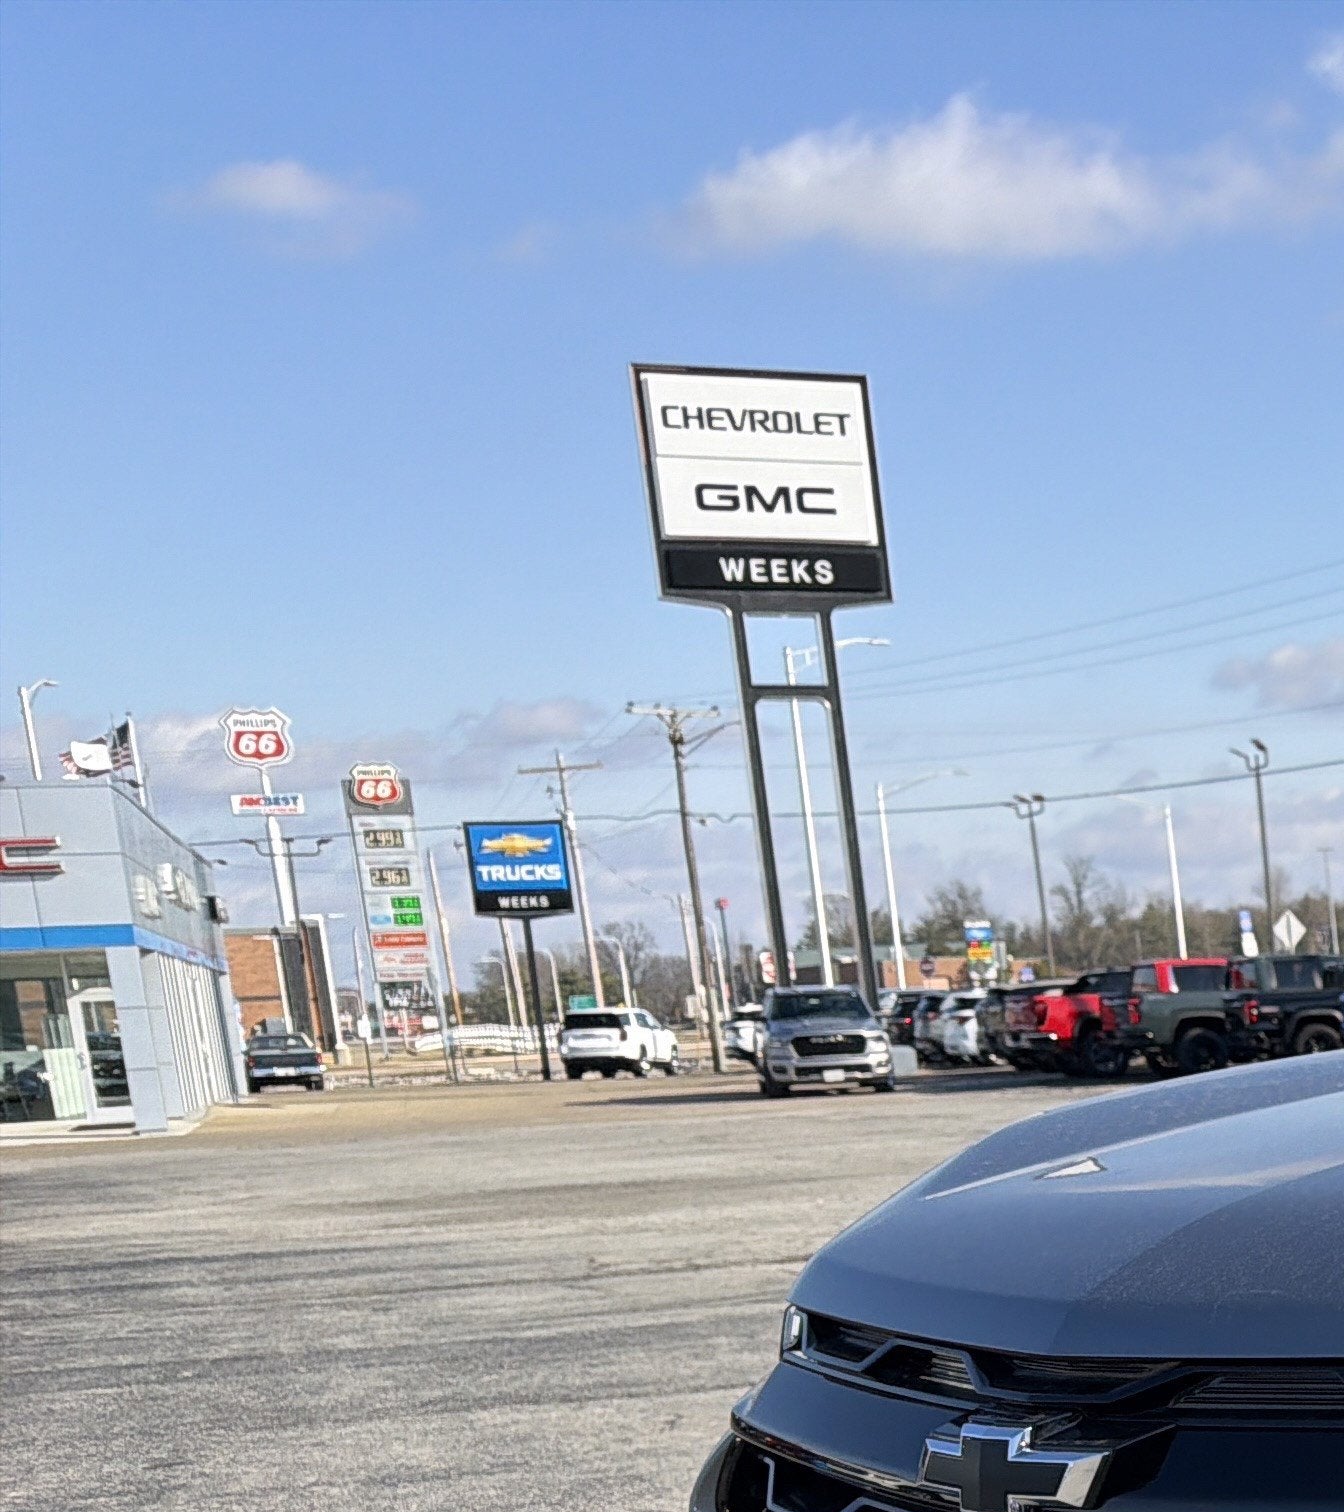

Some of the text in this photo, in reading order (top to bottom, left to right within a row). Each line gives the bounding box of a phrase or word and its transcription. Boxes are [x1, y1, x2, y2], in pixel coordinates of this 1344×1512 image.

[660, 405, 851, 436] CHEVROLET
[694, 483, 837, 515] GMC
[718, 556, 835, 585] WEEKS
[233, 719, 277, 728] PHILLIPS
[238, 733, 277, 755] 66
[361, 780, 392, 799] 66
[477, 864, 562, 882] TRUCKS
[497, 895, 550, 908] WEEKS
